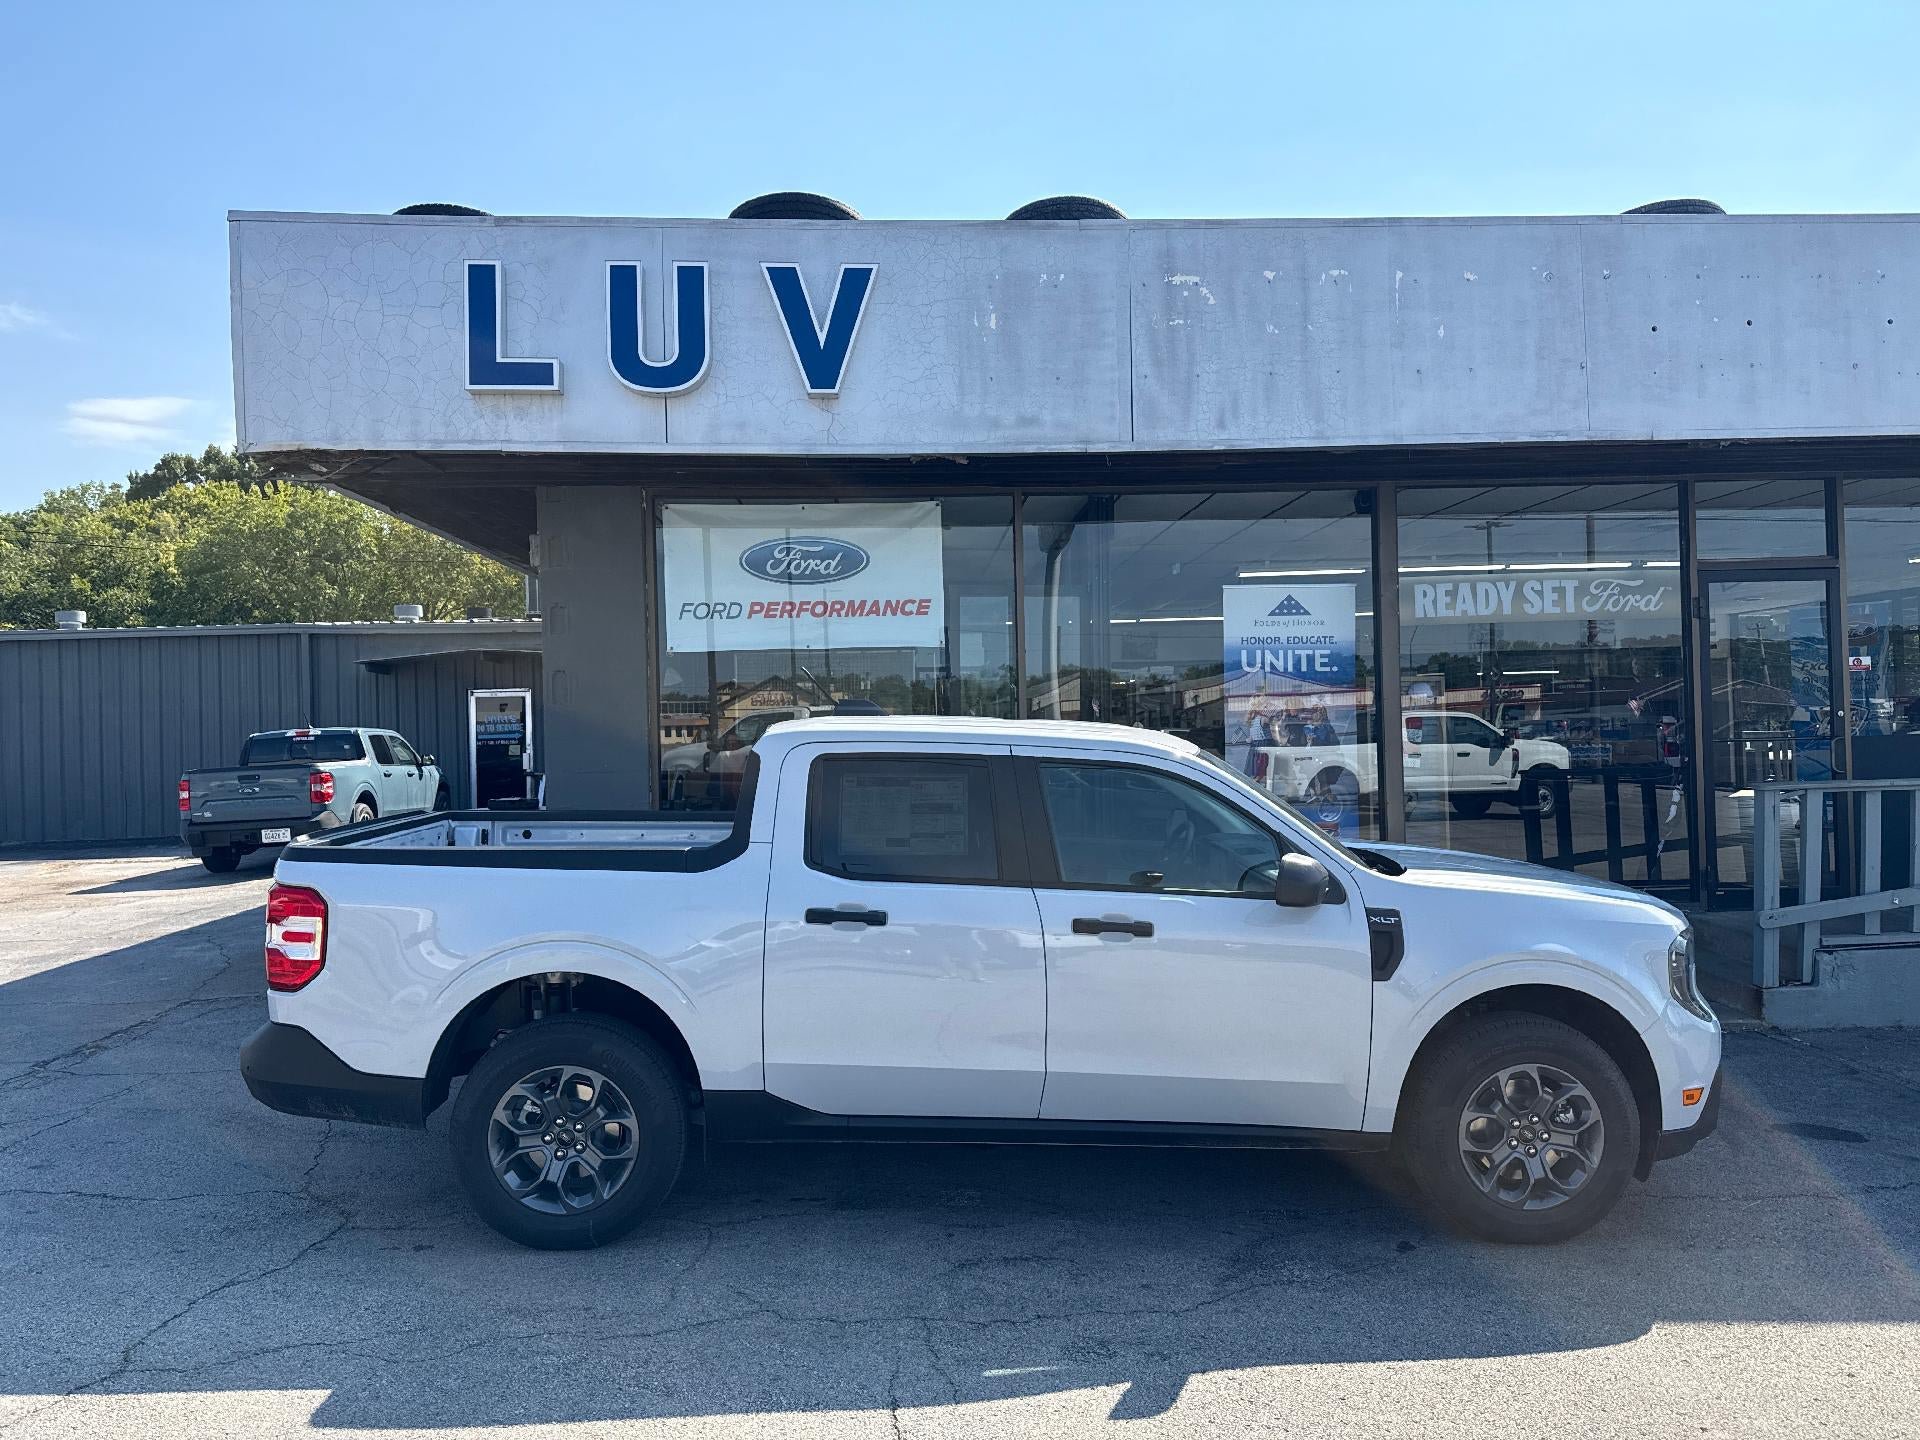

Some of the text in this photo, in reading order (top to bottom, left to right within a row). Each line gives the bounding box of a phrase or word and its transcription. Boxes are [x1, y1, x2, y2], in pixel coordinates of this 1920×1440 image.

[766, 544, 842, 576] Ford
[678, 598, 932, 620] FORD PERFORMANCE
[1414, 580, 1517, 618] READY
[1523, 579, 1579, 615] SET
[1241, 636, 1338, 645] HONOR. EDUCATE.
[1241, 649, 1339, 673] UNITE.
[1370, 916, 1399, 924] XLT
